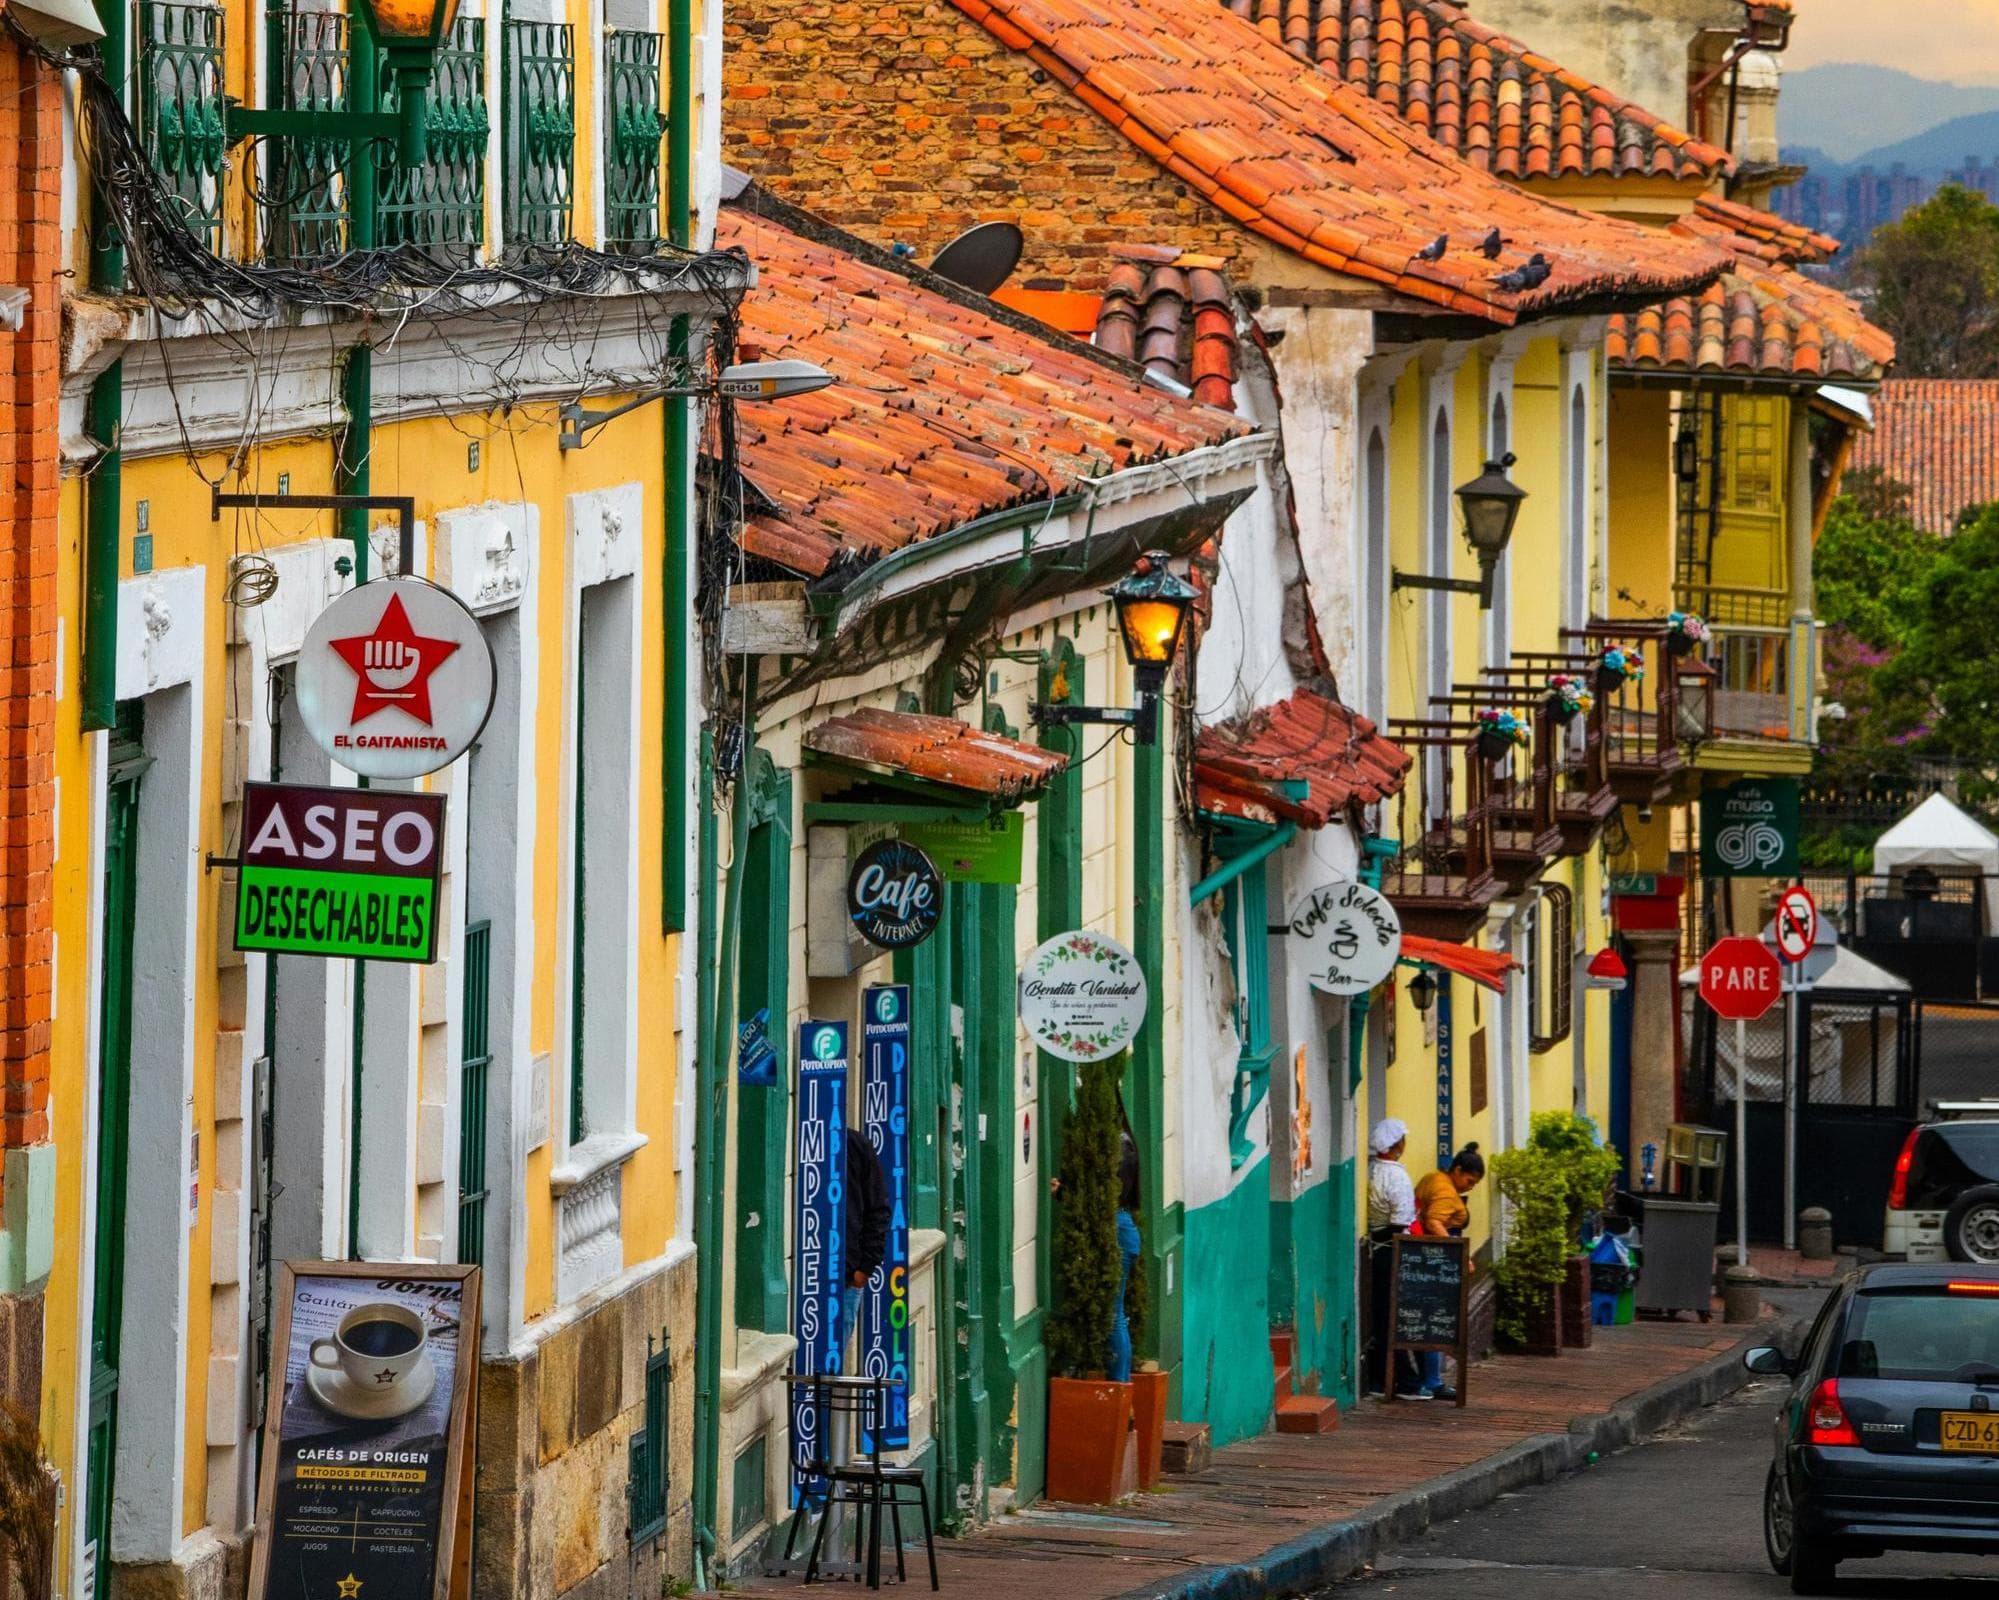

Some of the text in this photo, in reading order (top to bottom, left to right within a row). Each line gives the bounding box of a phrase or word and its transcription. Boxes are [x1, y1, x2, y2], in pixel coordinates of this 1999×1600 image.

[334, 735, 447, 749] EL GAITANISTA
[1726, 800, 1774, 812] musa
[248, 802, 434, 867] ASEO
[855, 864, 934, 920] Café
[244, 884, 425, 949] DESECHABLES
[1293, 892, 1333, 939] Café
[872, 916, 924, 941] INTERNET
[1327, 965, 1352, 985] Bar
[1711, 966, 1770, 991] PARE
[1025, 980, 1141, 997] Bendita Vanidad
[1438, 1025, 1449, 1156] SCANNER
[889, 1042, 908, 1427] DIGITAL COLOR
[1945, 1420, 1978, 1440] CZD
[297, 1447, 429, 1464] CAFÉS DE ORIGEN
[302, 1467, 419, 1480] MÉTODOS DE FILTRADO
[349, 1485, 421, 1494] ESPECIALIDAD
[299, 1506, 338, 1514] ESPRESSO
[293, 1525, 340, 1534] MOCACCINO
[373, 1528, 414, 1537] COCTELES
[302, 1543, 328, 1551] JUGOS
[369, 1544, 415, 1553] PASTELERÍA
